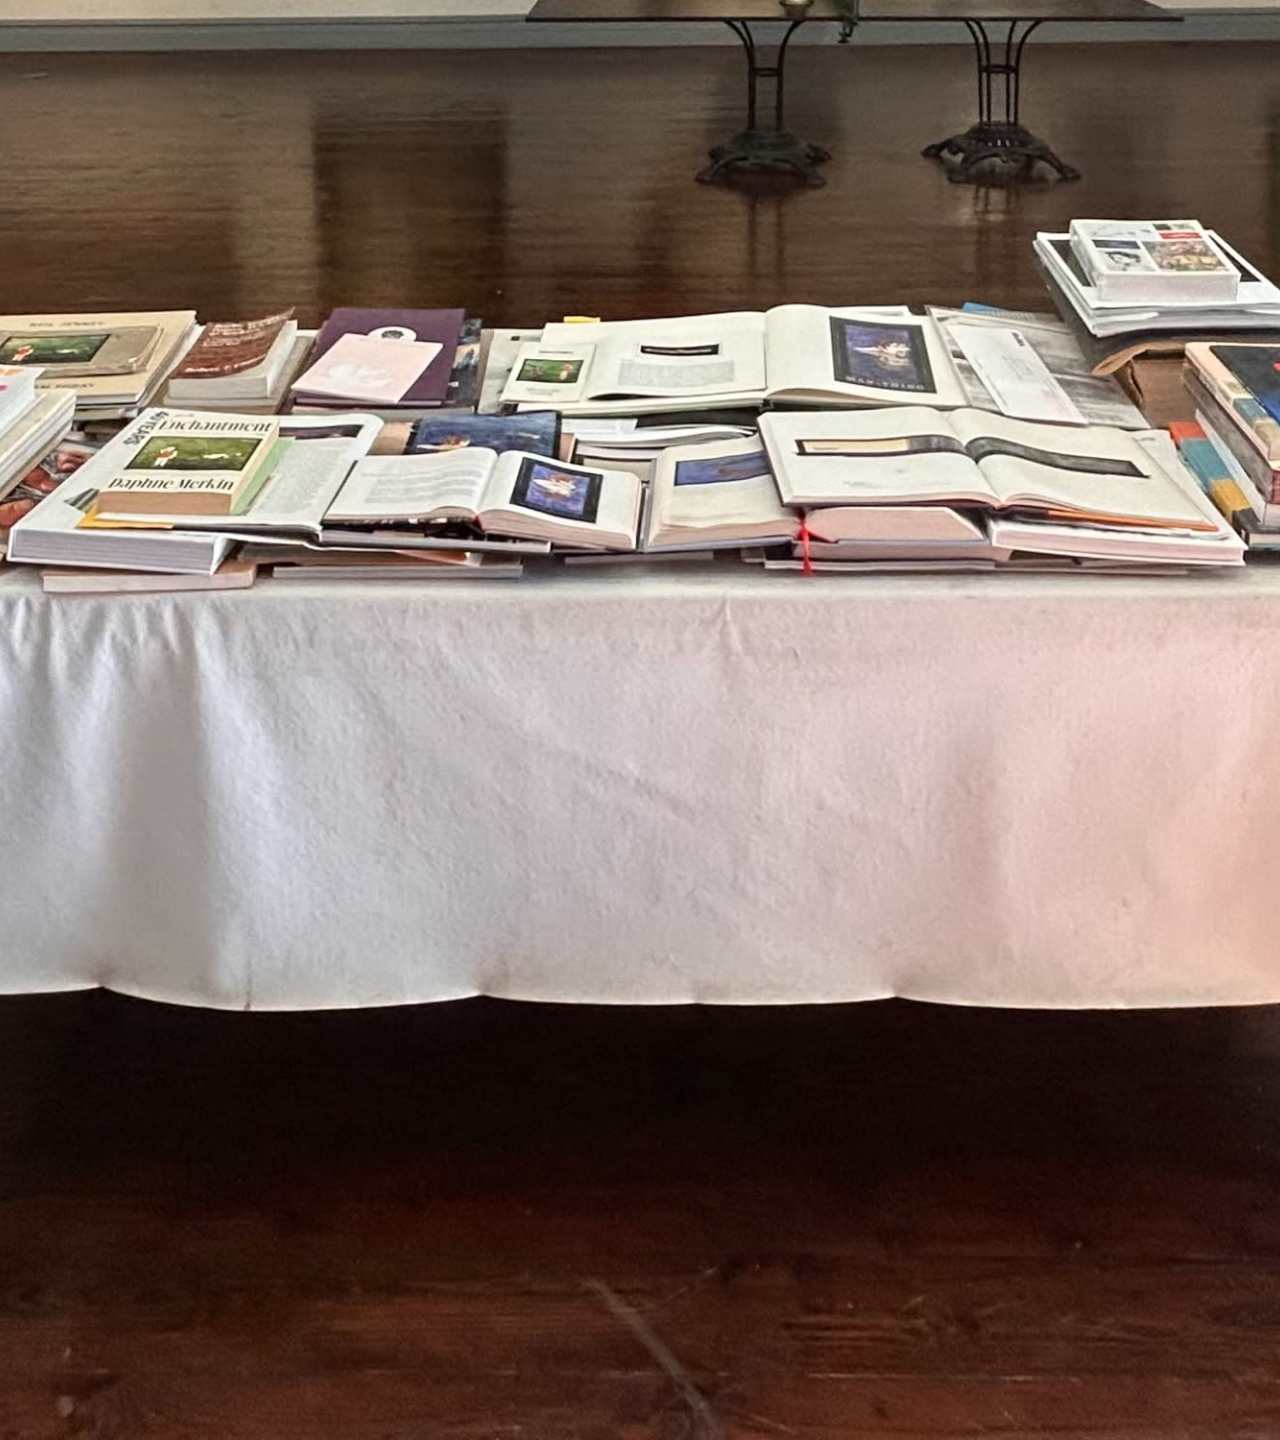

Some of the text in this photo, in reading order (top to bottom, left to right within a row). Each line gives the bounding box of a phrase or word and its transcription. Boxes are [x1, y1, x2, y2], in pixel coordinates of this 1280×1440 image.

[157, 419, 275, 433] Enchantment
[107, 477, 236, 491] Daphne Merkin
